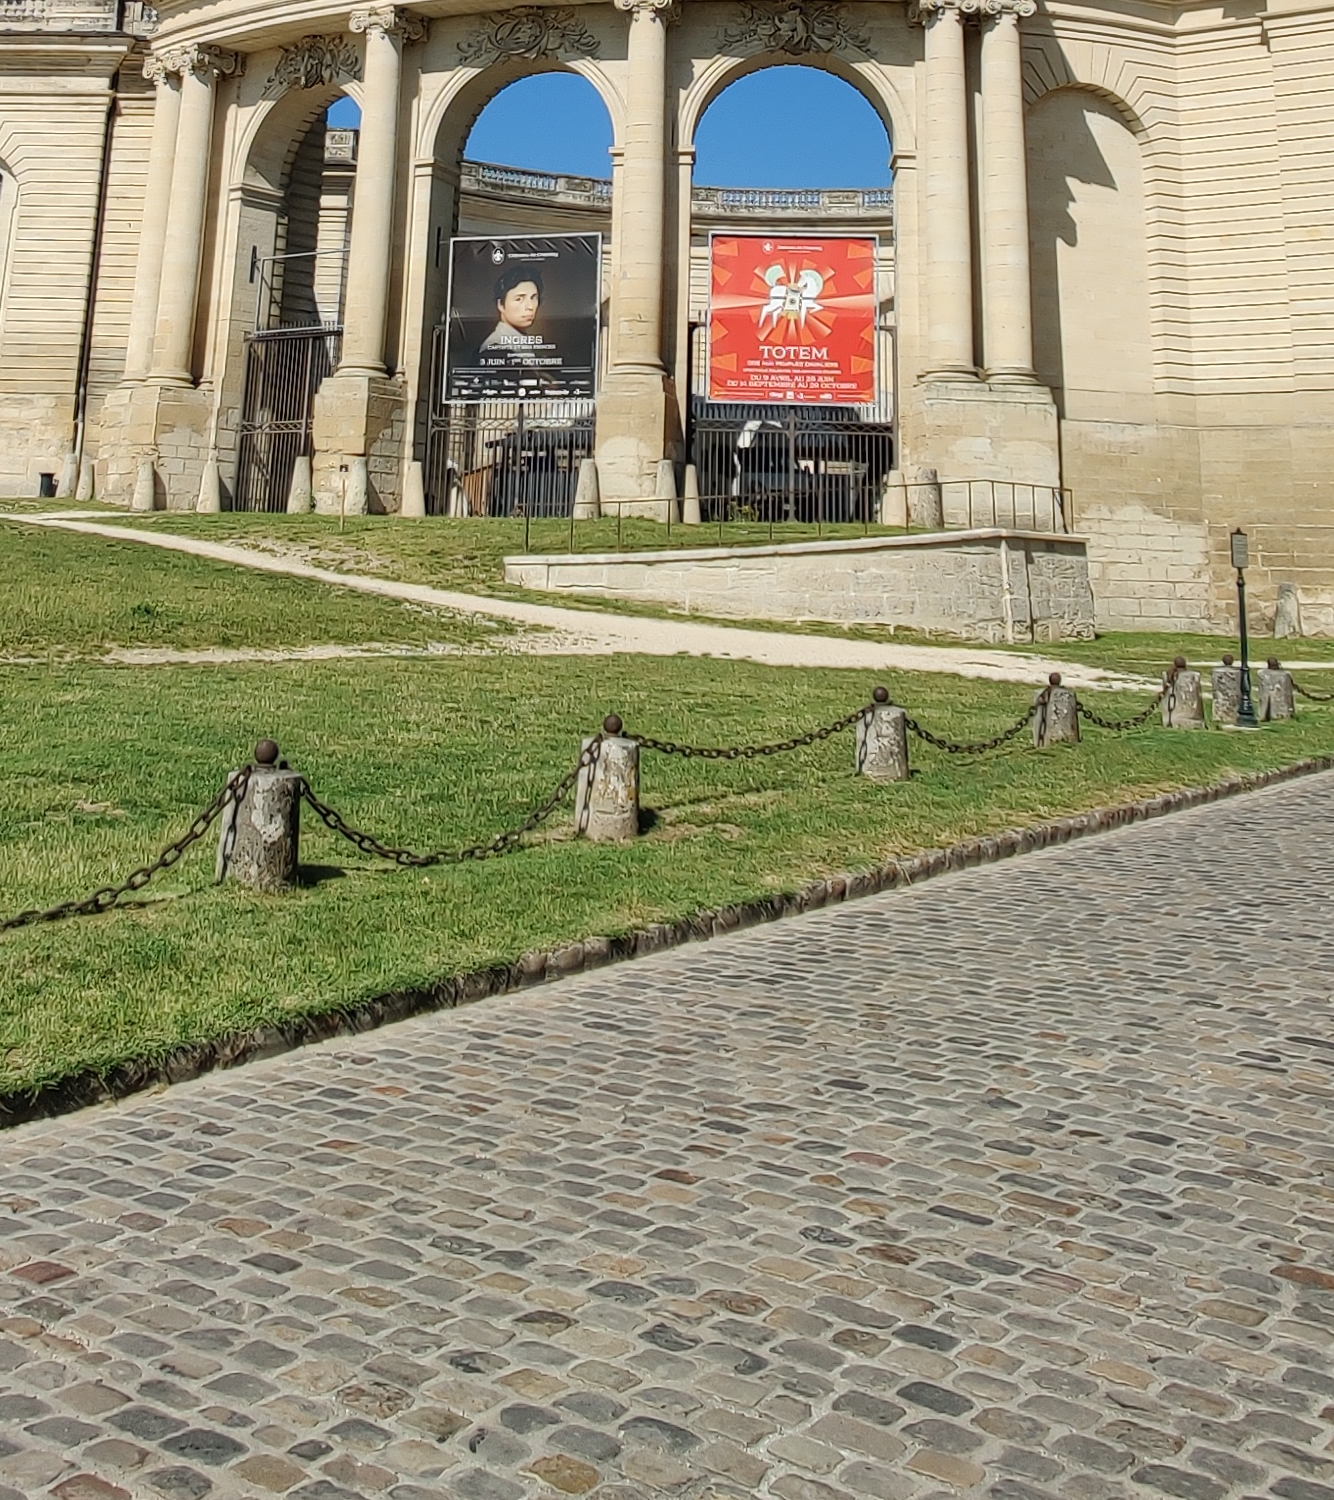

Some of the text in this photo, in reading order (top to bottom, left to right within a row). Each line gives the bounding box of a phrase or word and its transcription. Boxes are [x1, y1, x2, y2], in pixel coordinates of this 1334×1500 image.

[500, 335, 543, 345] INGRES
[758, 345, 829, 360] TOTEM
[479, 358, 485, 366] 3
[487, 358, 505, 366] JUIN
[522, 357, 563, 366] OCTOBRE
[797, 381, 808, 389] AU
